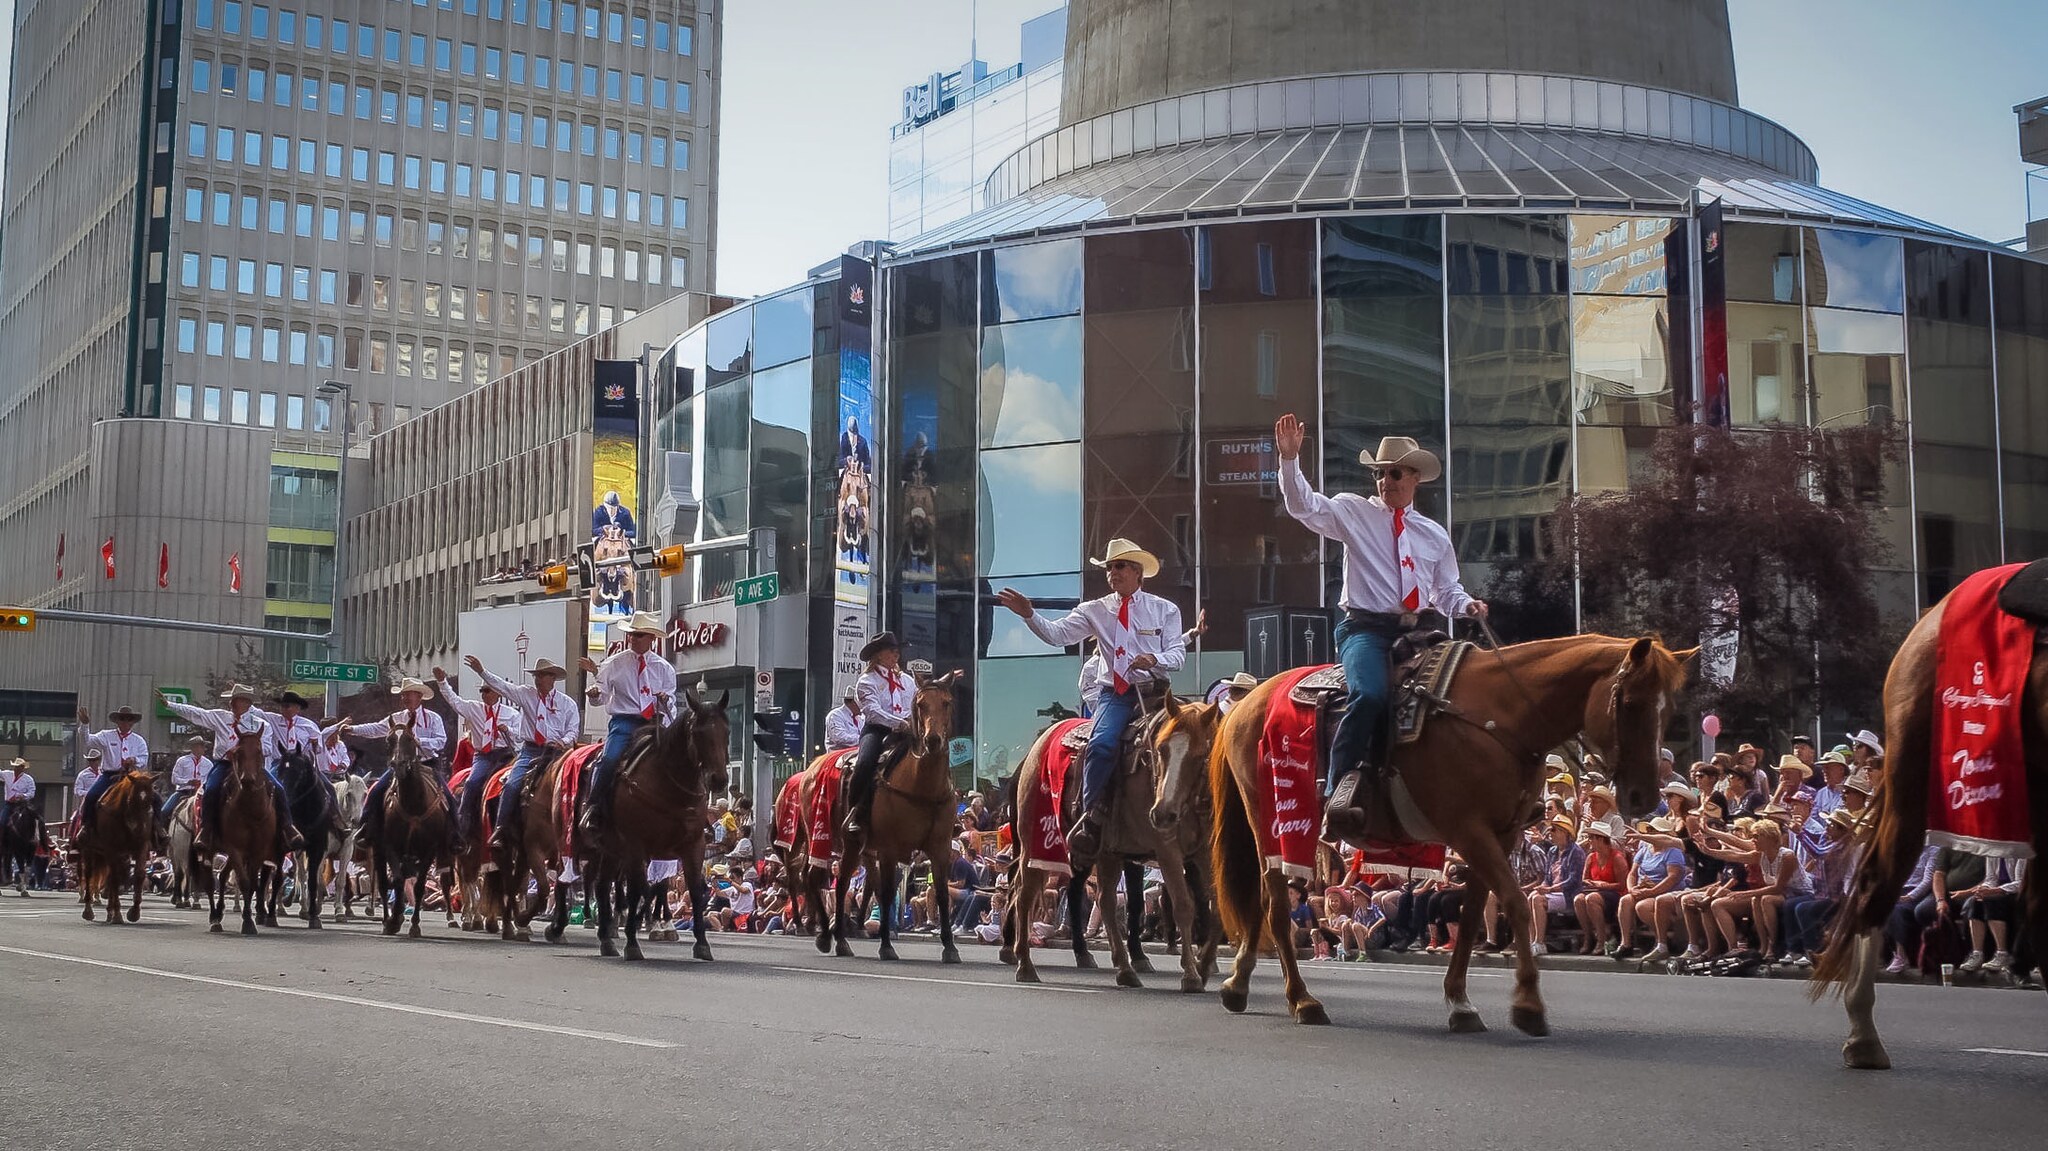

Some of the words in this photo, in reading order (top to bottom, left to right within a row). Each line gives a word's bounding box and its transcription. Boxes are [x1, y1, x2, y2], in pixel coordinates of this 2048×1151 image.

[903, 72, 941, 124] Bell
[1221, 442, 1273, 455] RUTH'S
[1218, 471, 1257, 482] STEAK
[1261, 471, 1279, 481] HO
[737, 586, 744, 601] 9
[748, 581, 764, 599] AVE
[768, 579, 775, 595] S
[295, 664, 340, 677] CENTRE
[347, 667, 359, 678] ST
[366, 669, 374, 679] S
[837, 661, 851, 674] JULY
[851, 662, 862, 675] 5-9
